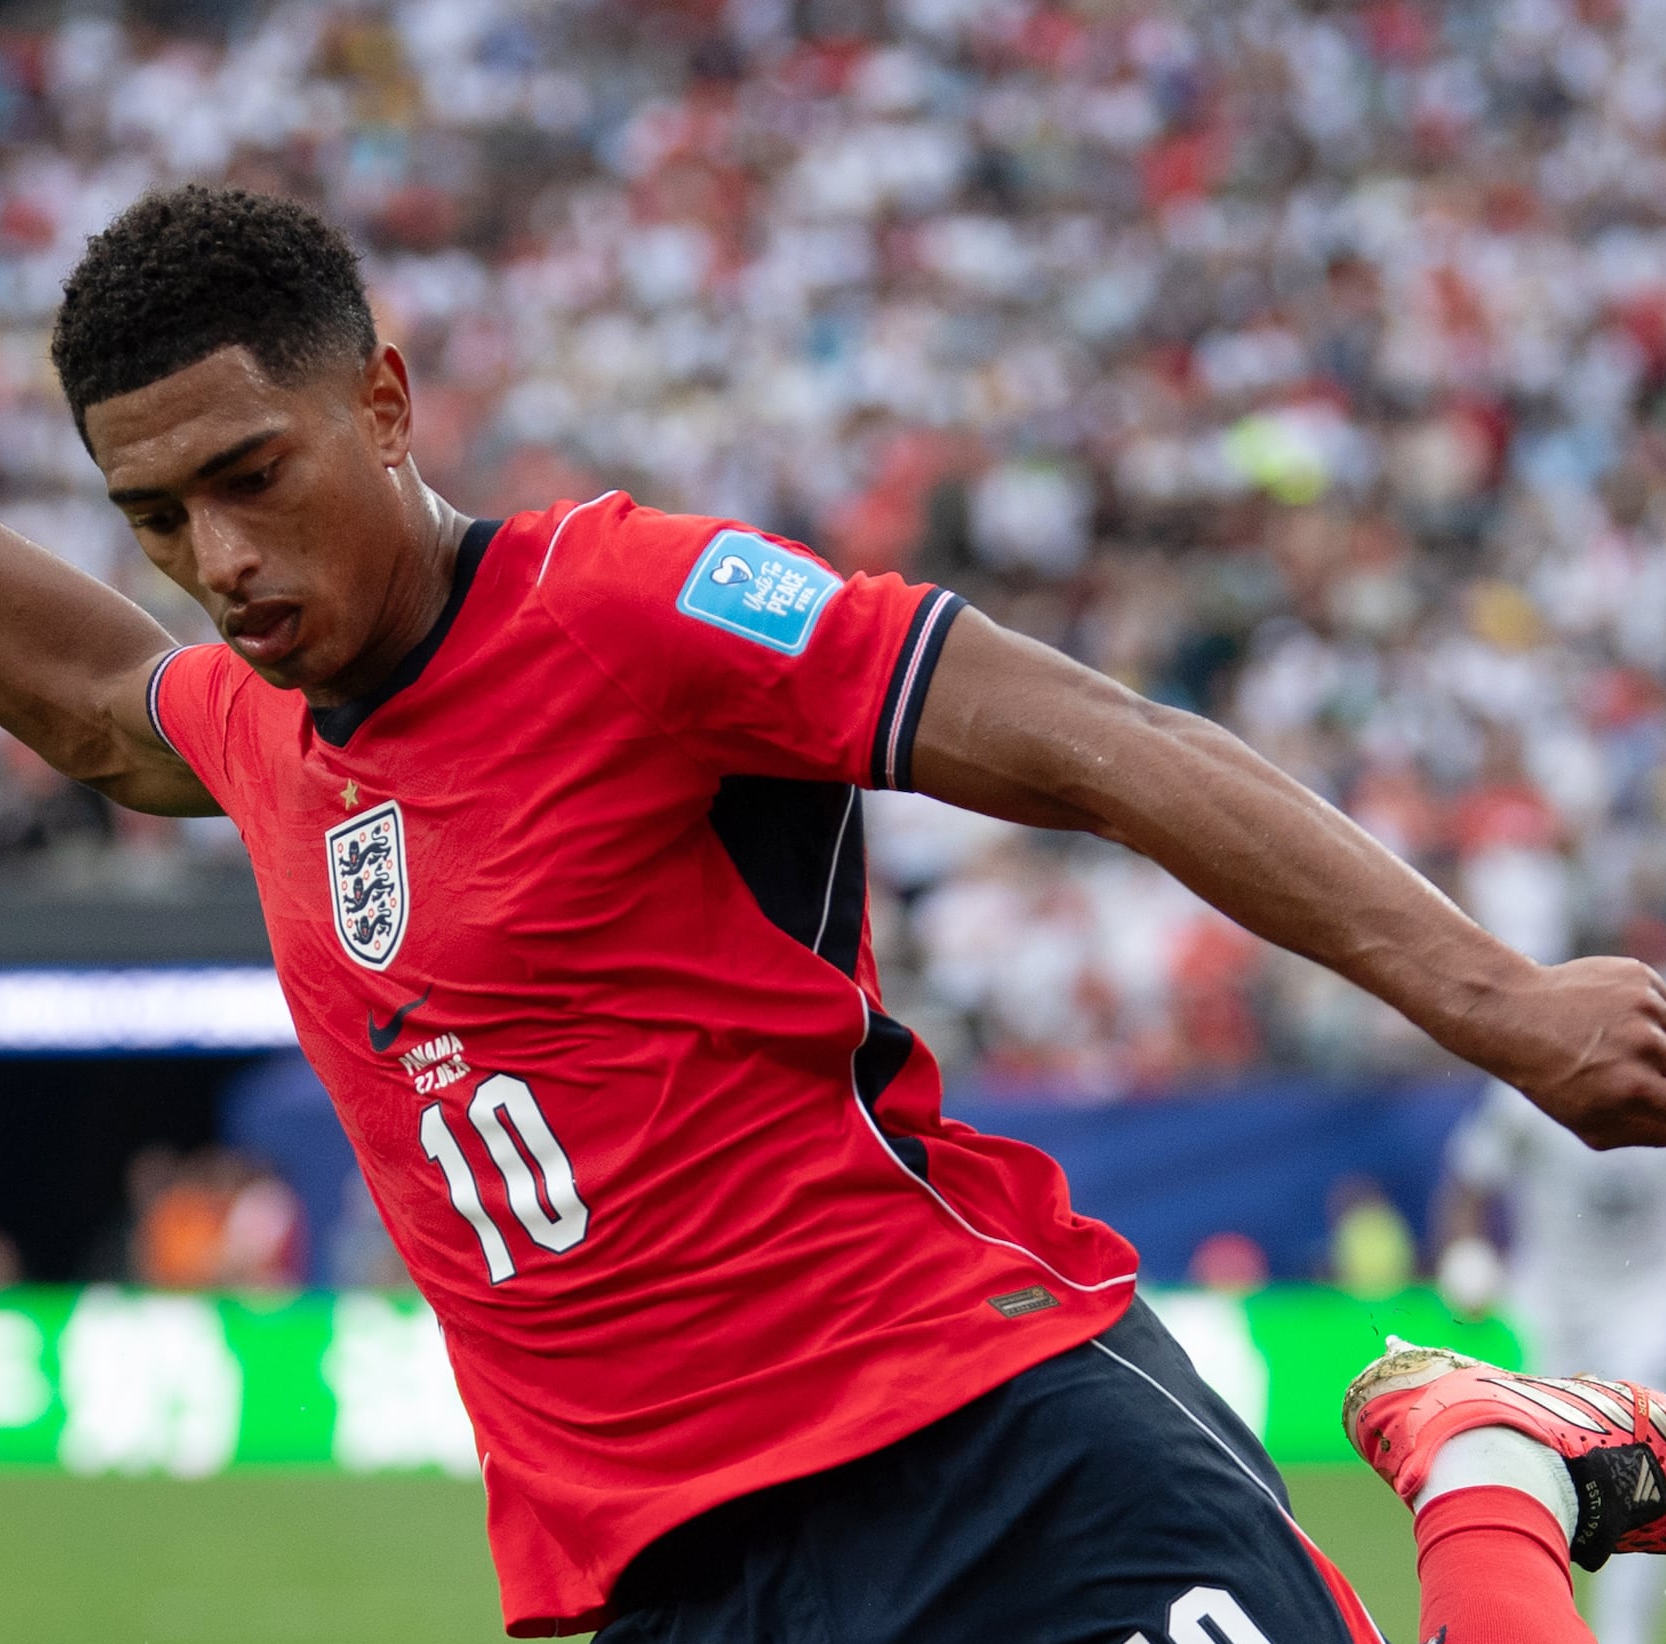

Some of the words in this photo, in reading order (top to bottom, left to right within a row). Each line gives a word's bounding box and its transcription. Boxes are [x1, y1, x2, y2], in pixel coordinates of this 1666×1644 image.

[765, 568, 809, 617] PEACE
[794, 586, 817, 612] FIFA
[398, 1031, 464, 1077] PANAMA
[419, 1072, 590, 1286] 10
[1585, 1480, 1602, 1510] EST.
[1577, 1515, 1601, 1545] 1994
